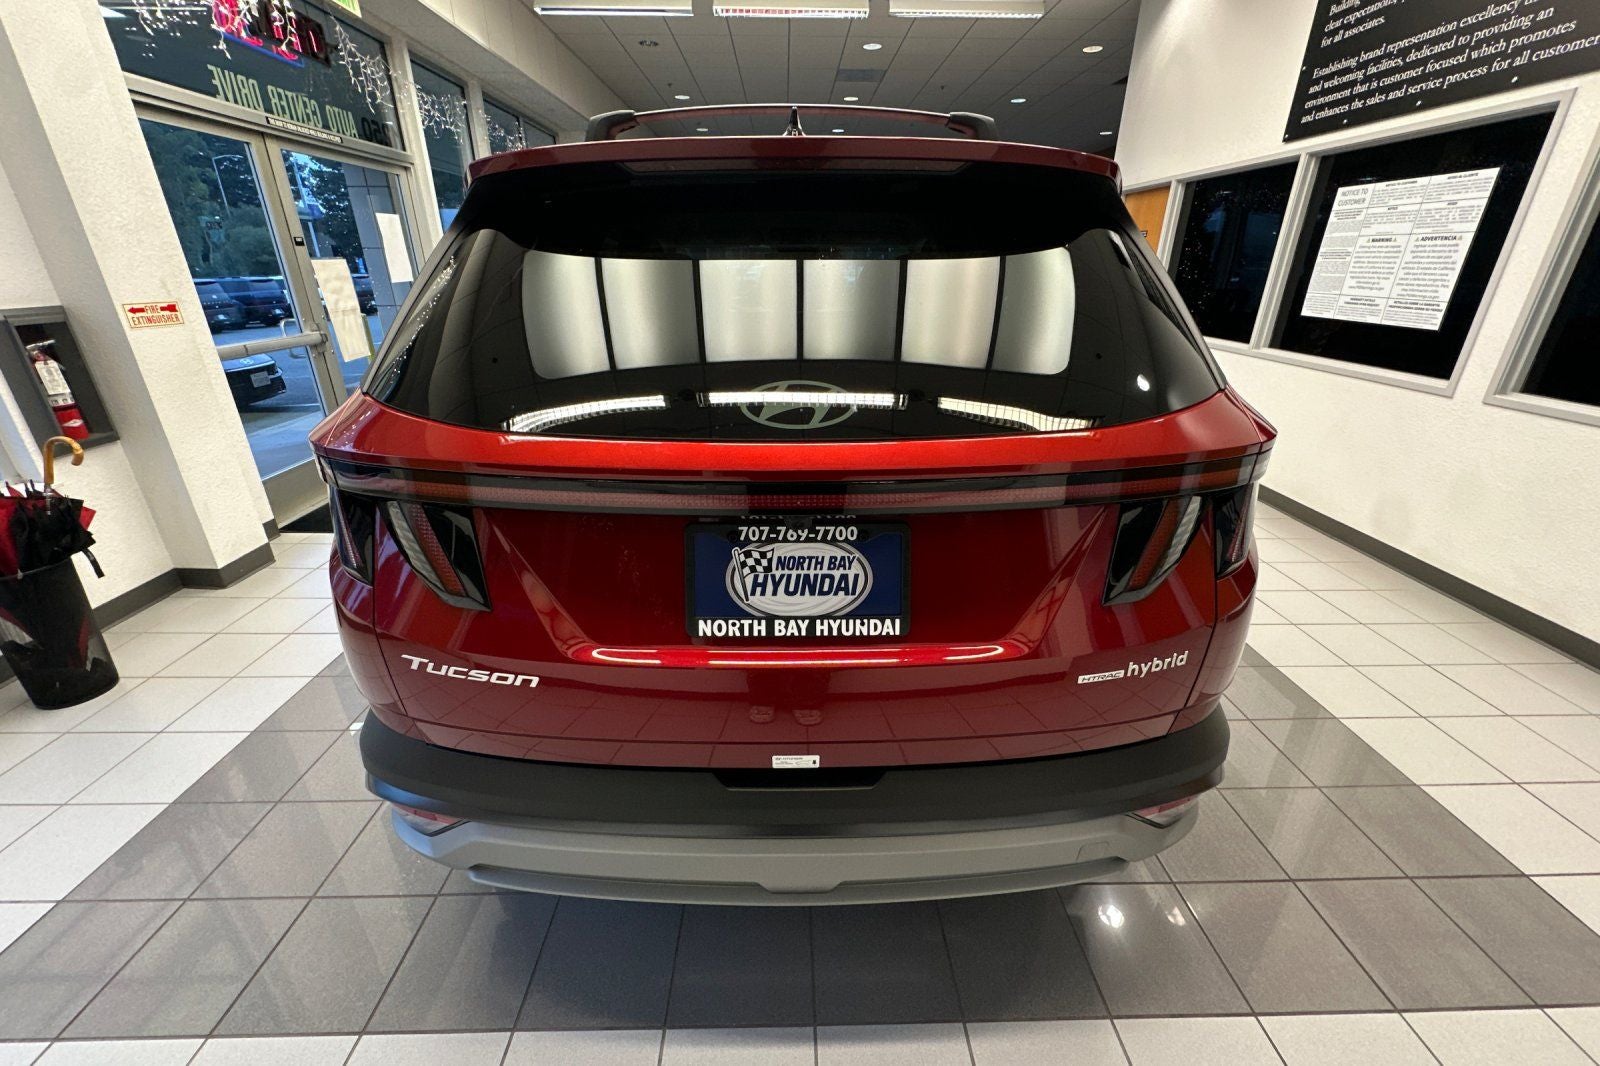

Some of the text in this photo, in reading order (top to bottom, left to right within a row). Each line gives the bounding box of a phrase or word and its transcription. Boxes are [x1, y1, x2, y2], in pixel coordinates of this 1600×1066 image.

[1324, 19, 1343, 32] clear
[1312, 0, 1520, 79] Establishing brand representation excellency
[1320, 36, 1333, 48] for
[1333, 30, 1344, 43] all
[1308, 80, 1323, 94] and
[1323, 69, 1365, 89] welcoming
[1406, 35, 1456, 62] dedicated
[1457, 34, 1470, 46] to
[1470, 14, 1535, 46] providing
[1536, 7, 1554, 21] an
[1304, 20, 1577, 109] environment that is customer focused which promotes
[1300, 110, 1315, 124] and
[1315, 103, 1350, 120] enhances
[1351, 98, 1364, 110] the
[1365, 92, 1387, 107] sales
[1388, 84, 1406, 100] and
[1407, 76, 1442, 95] service
[1443, 65, 1489, 89] process
[1491, 57, 1511, 73] for
[1513, 50, 1530, 66] all
[144, 305, 160, 314] FIRE
[131, 313, 180, 326] EXTINGUISHER
[738, 526, 858, 541] 707-769-7700
[775, 555, 857, 571] NORTH BAY
[749, 573, 862, 597] HYUNDAI
[698, 618, 901, 637] NORTH BAY HYUNDAI
[1126, 650, 1189, 678] hybrid
